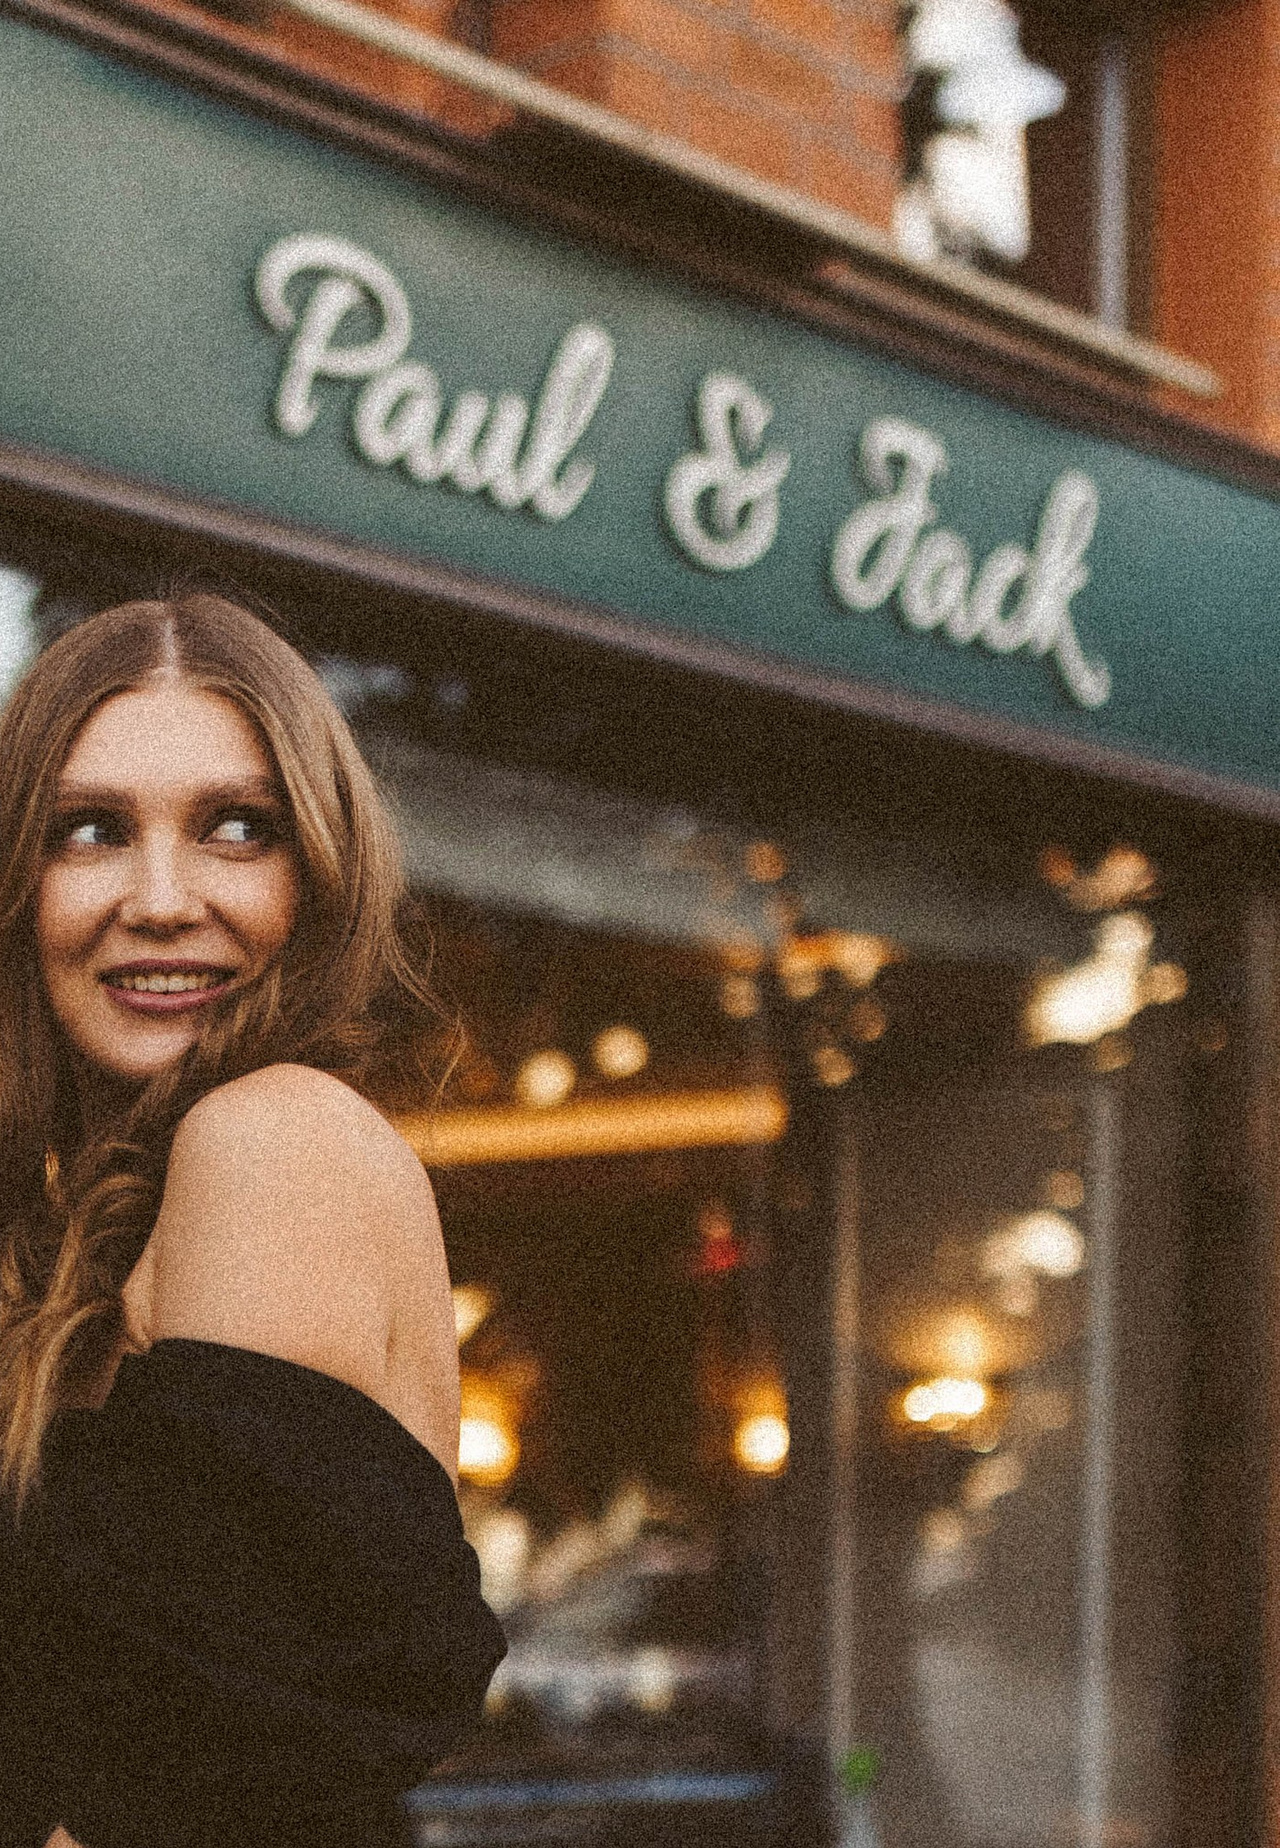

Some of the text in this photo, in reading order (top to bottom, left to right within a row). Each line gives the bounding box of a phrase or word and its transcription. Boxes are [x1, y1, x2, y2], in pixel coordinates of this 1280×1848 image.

[255, 231, 1111, 708] Paul & Jack
